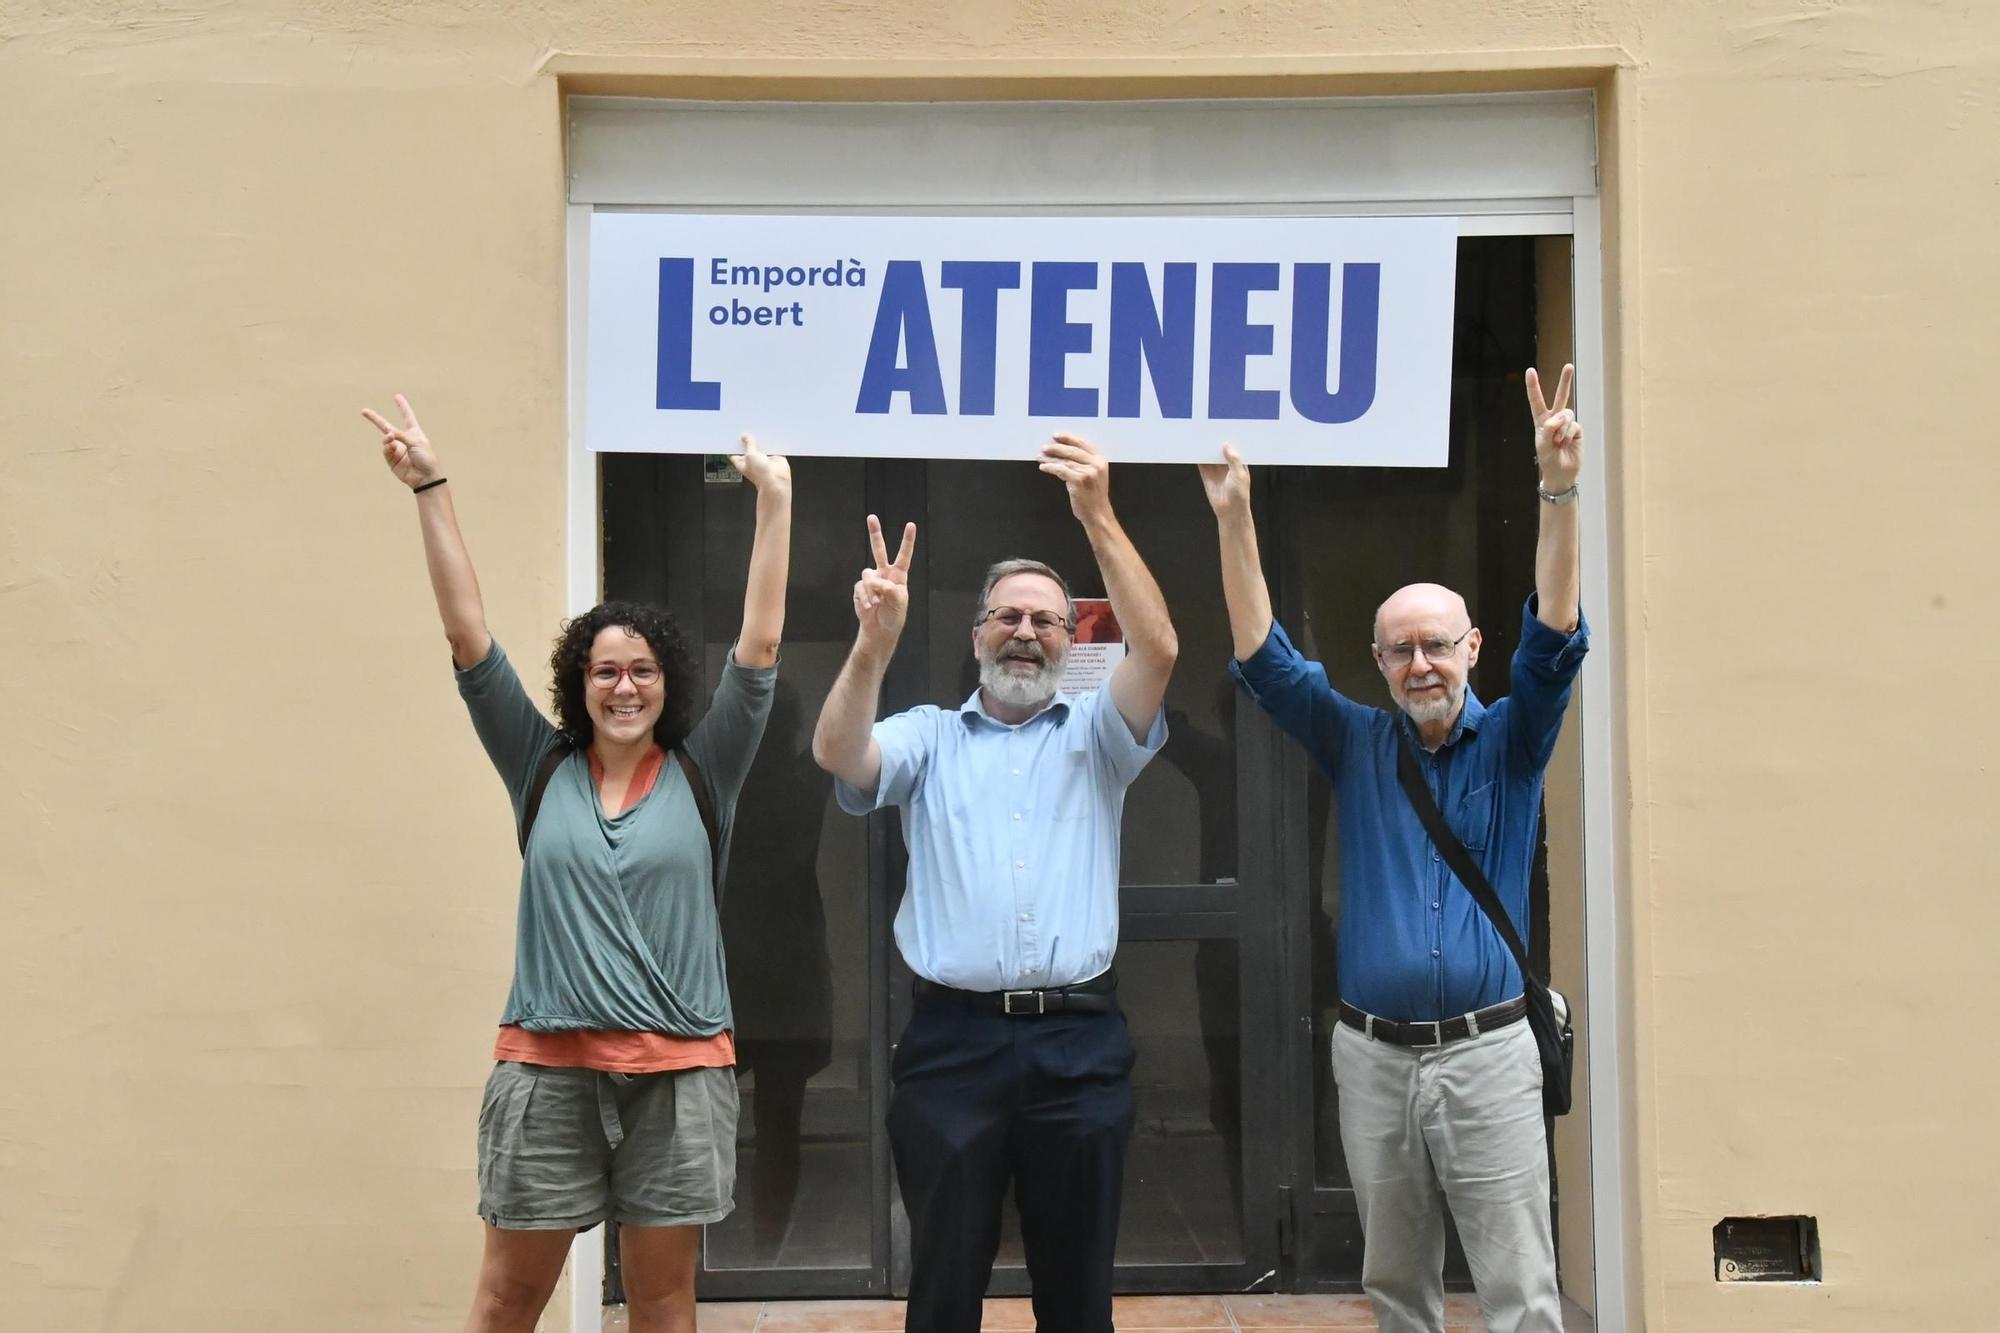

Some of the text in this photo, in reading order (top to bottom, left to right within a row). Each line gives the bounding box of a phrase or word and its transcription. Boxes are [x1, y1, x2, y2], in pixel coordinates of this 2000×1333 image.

[711, 258, 867, 292] Empordà
[709, 301, 804, 327] obert
[656, 257, 1381, 425] L ATENEU
